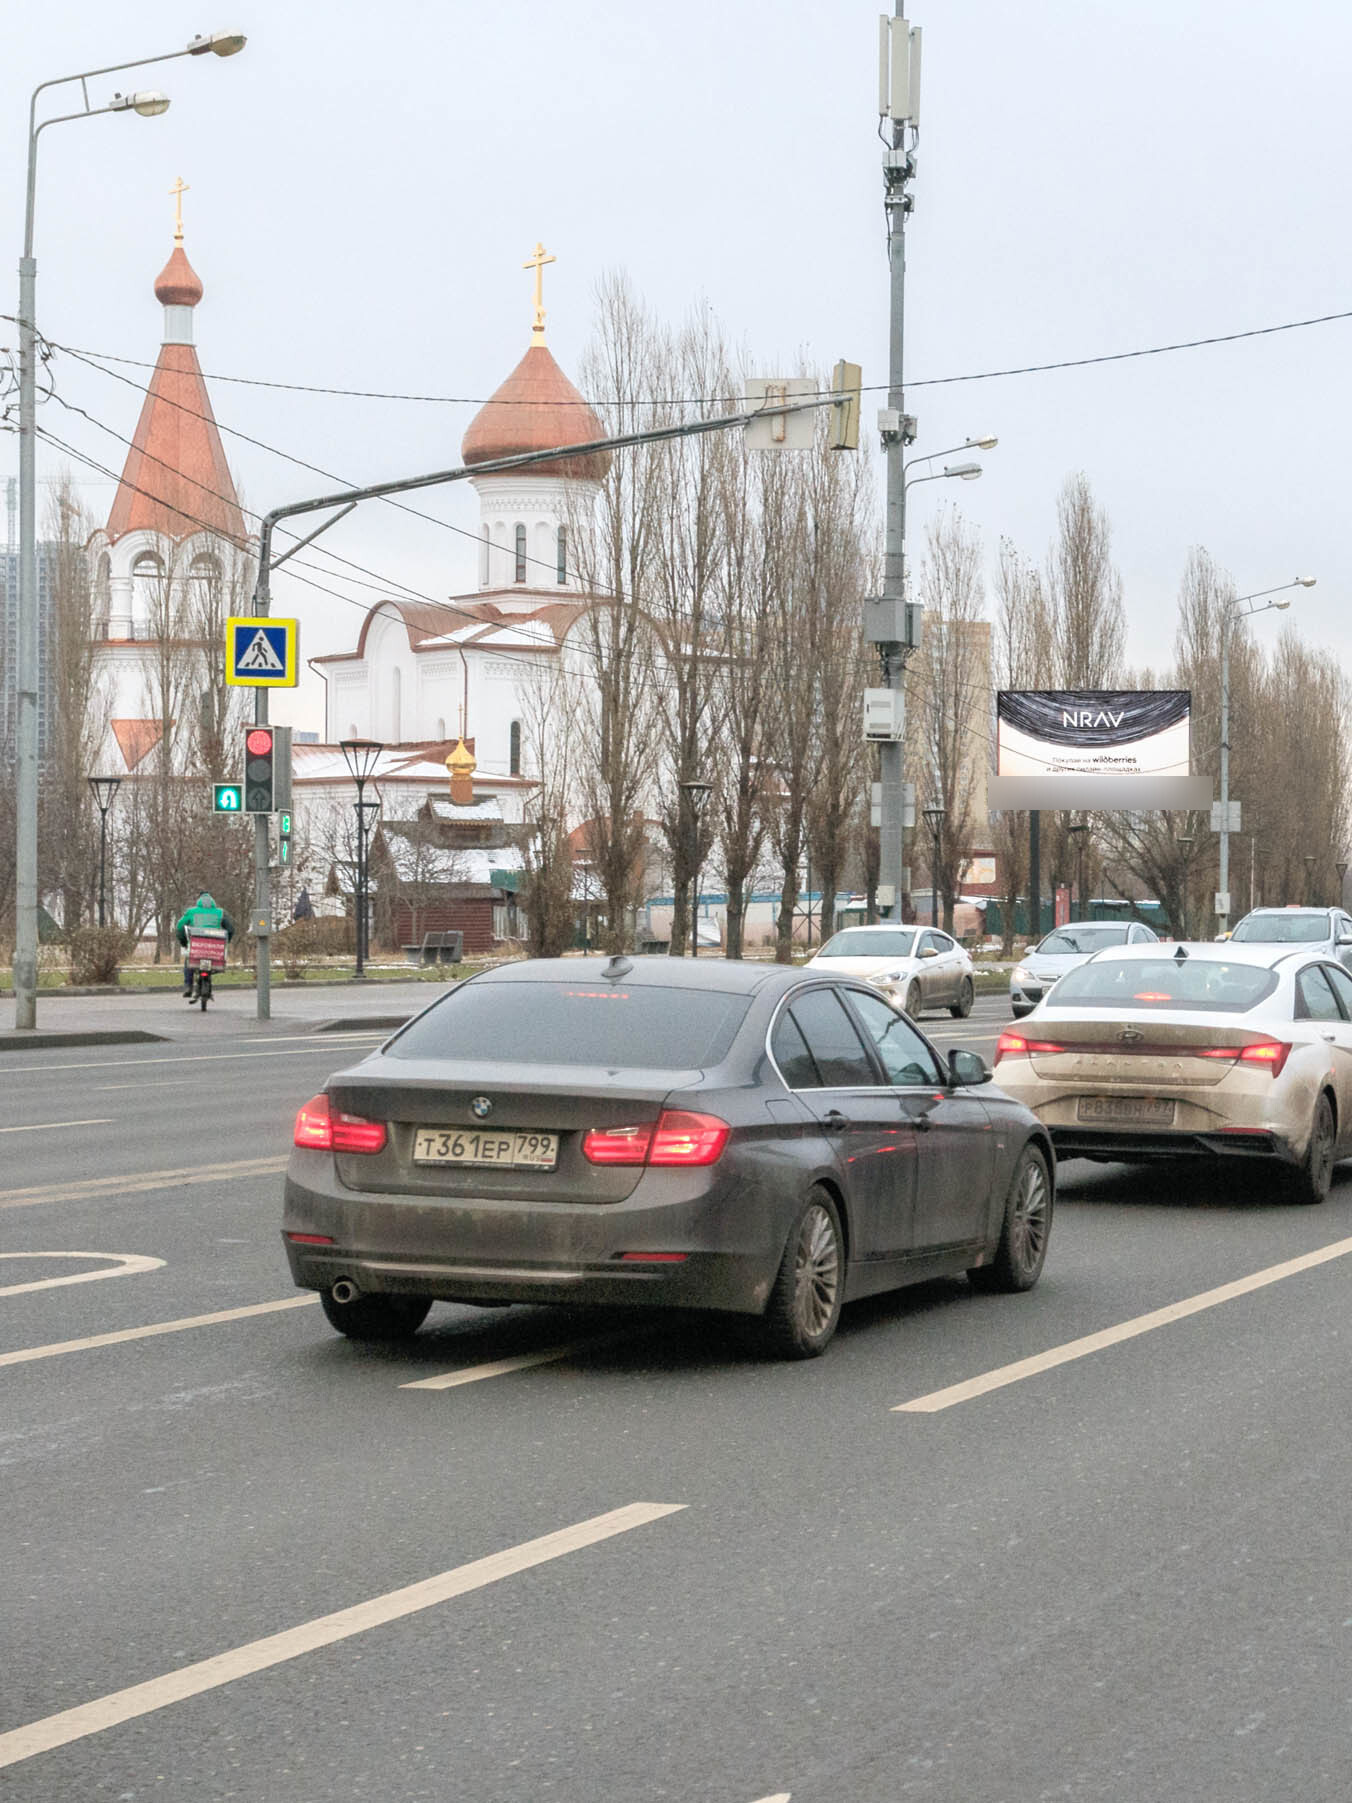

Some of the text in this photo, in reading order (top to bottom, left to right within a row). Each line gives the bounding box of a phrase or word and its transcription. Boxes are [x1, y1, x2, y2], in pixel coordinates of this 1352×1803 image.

[1062, 711, 1125, 728] NRAV
[424, 1133, 551, 1159] Т361ЕР 799
